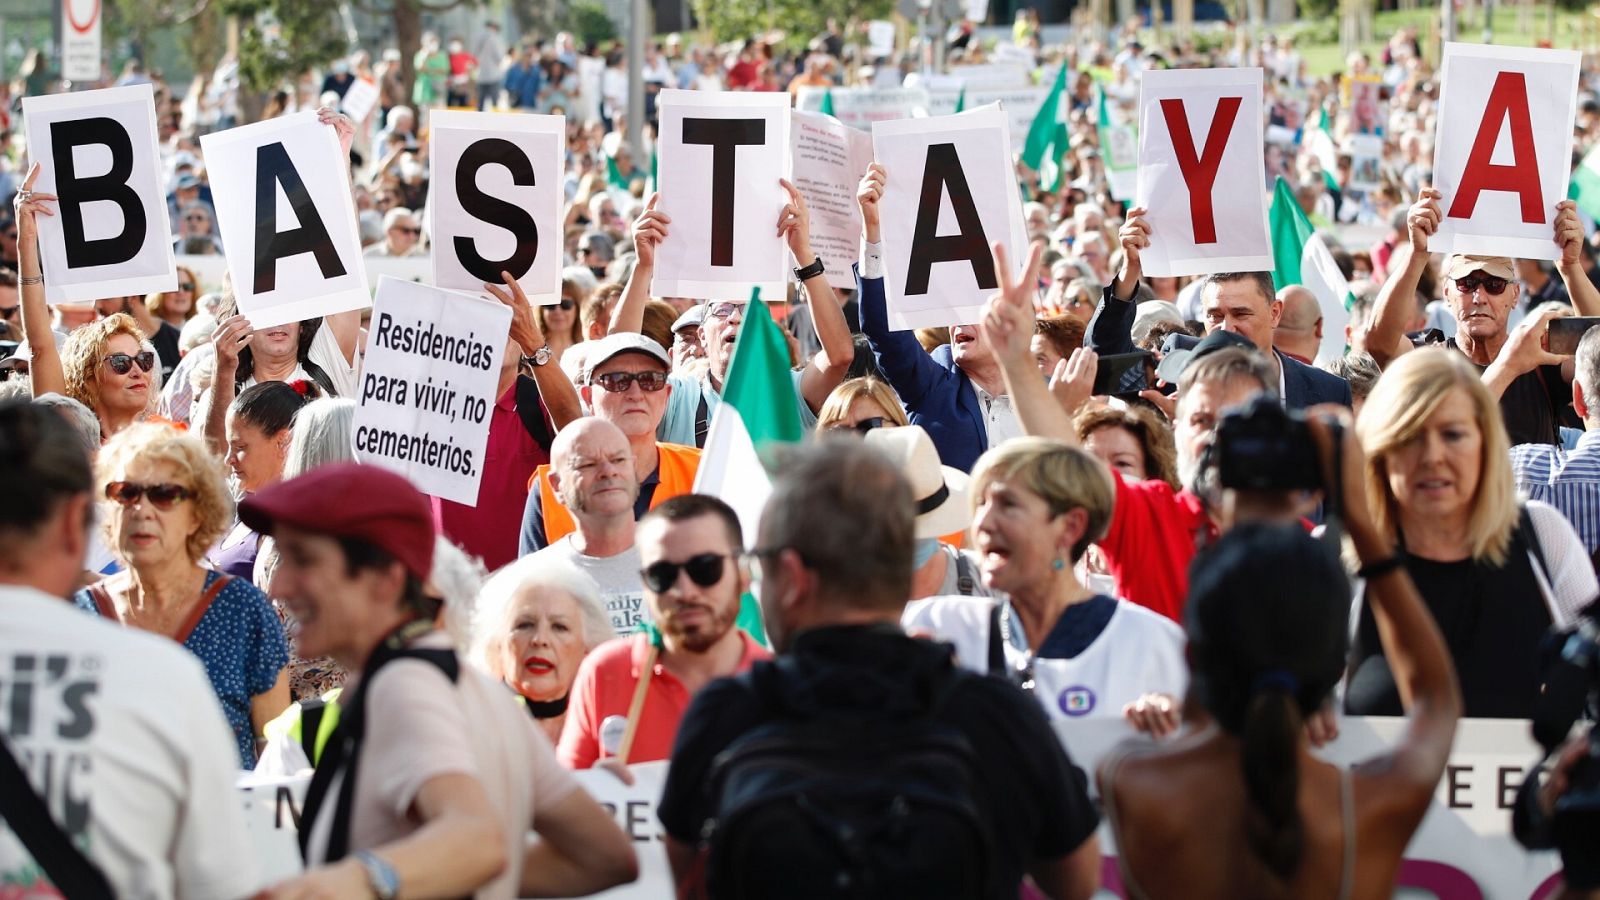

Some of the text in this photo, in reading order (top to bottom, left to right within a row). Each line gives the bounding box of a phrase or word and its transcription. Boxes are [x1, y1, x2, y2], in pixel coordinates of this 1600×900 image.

[375, 312, 493, 371] Residencias
[361, 372, 487, 424] para vivir, no
[356, 425, 476, 477] cementerios.
